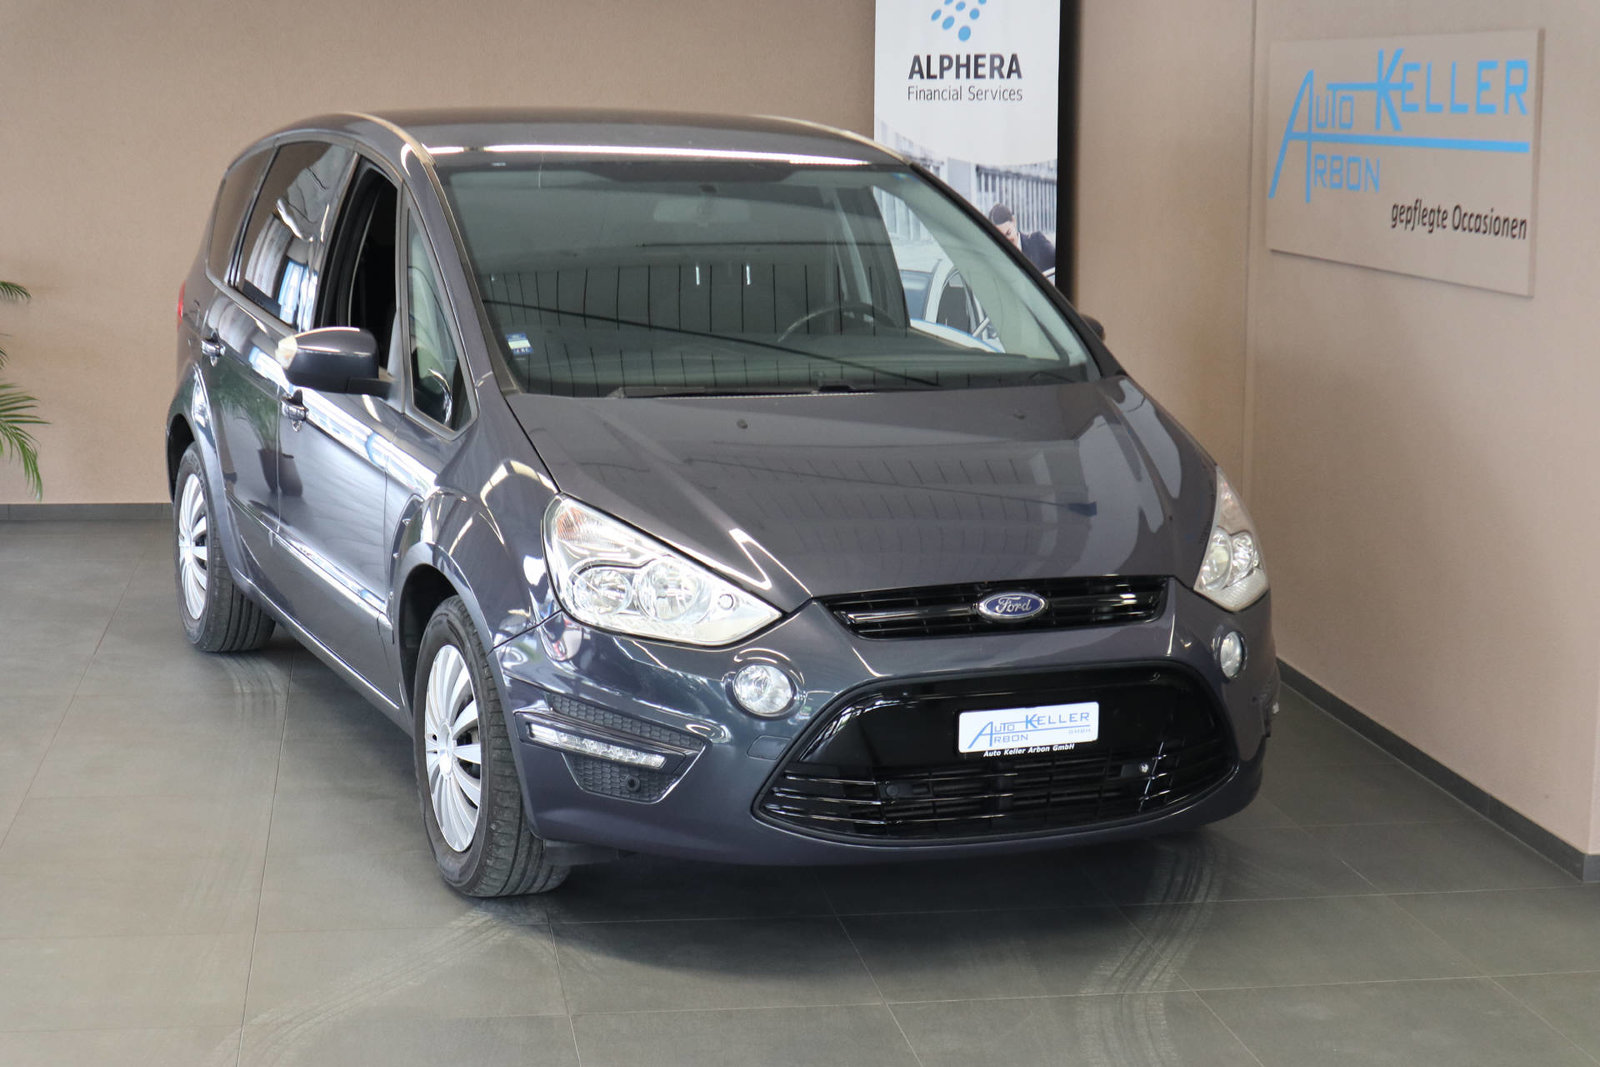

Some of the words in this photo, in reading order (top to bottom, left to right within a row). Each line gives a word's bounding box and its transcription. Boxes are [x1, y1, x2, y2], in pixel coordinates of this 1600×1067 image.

[908, 53, 1023, 80] ALPHERA
[907, 85, 963, 101] Financial
[968, 85, 1023, 101] Services
[1375, 48, 1529, 131] KELLER
[1391, 198, 1449, 234] gepflegte
[1452, 204, 1528, 240] Occasionen
[995, 596, 1032, 613] Ford
[1025, 712, 1090, 729] KELLER
[983, 749, 1002, 757] Auto
[1003, 748, 1027, 756] Keller
[1028, 746, 1050, 754] Arbon
[1052, 743, 1075, 751] GmbH
